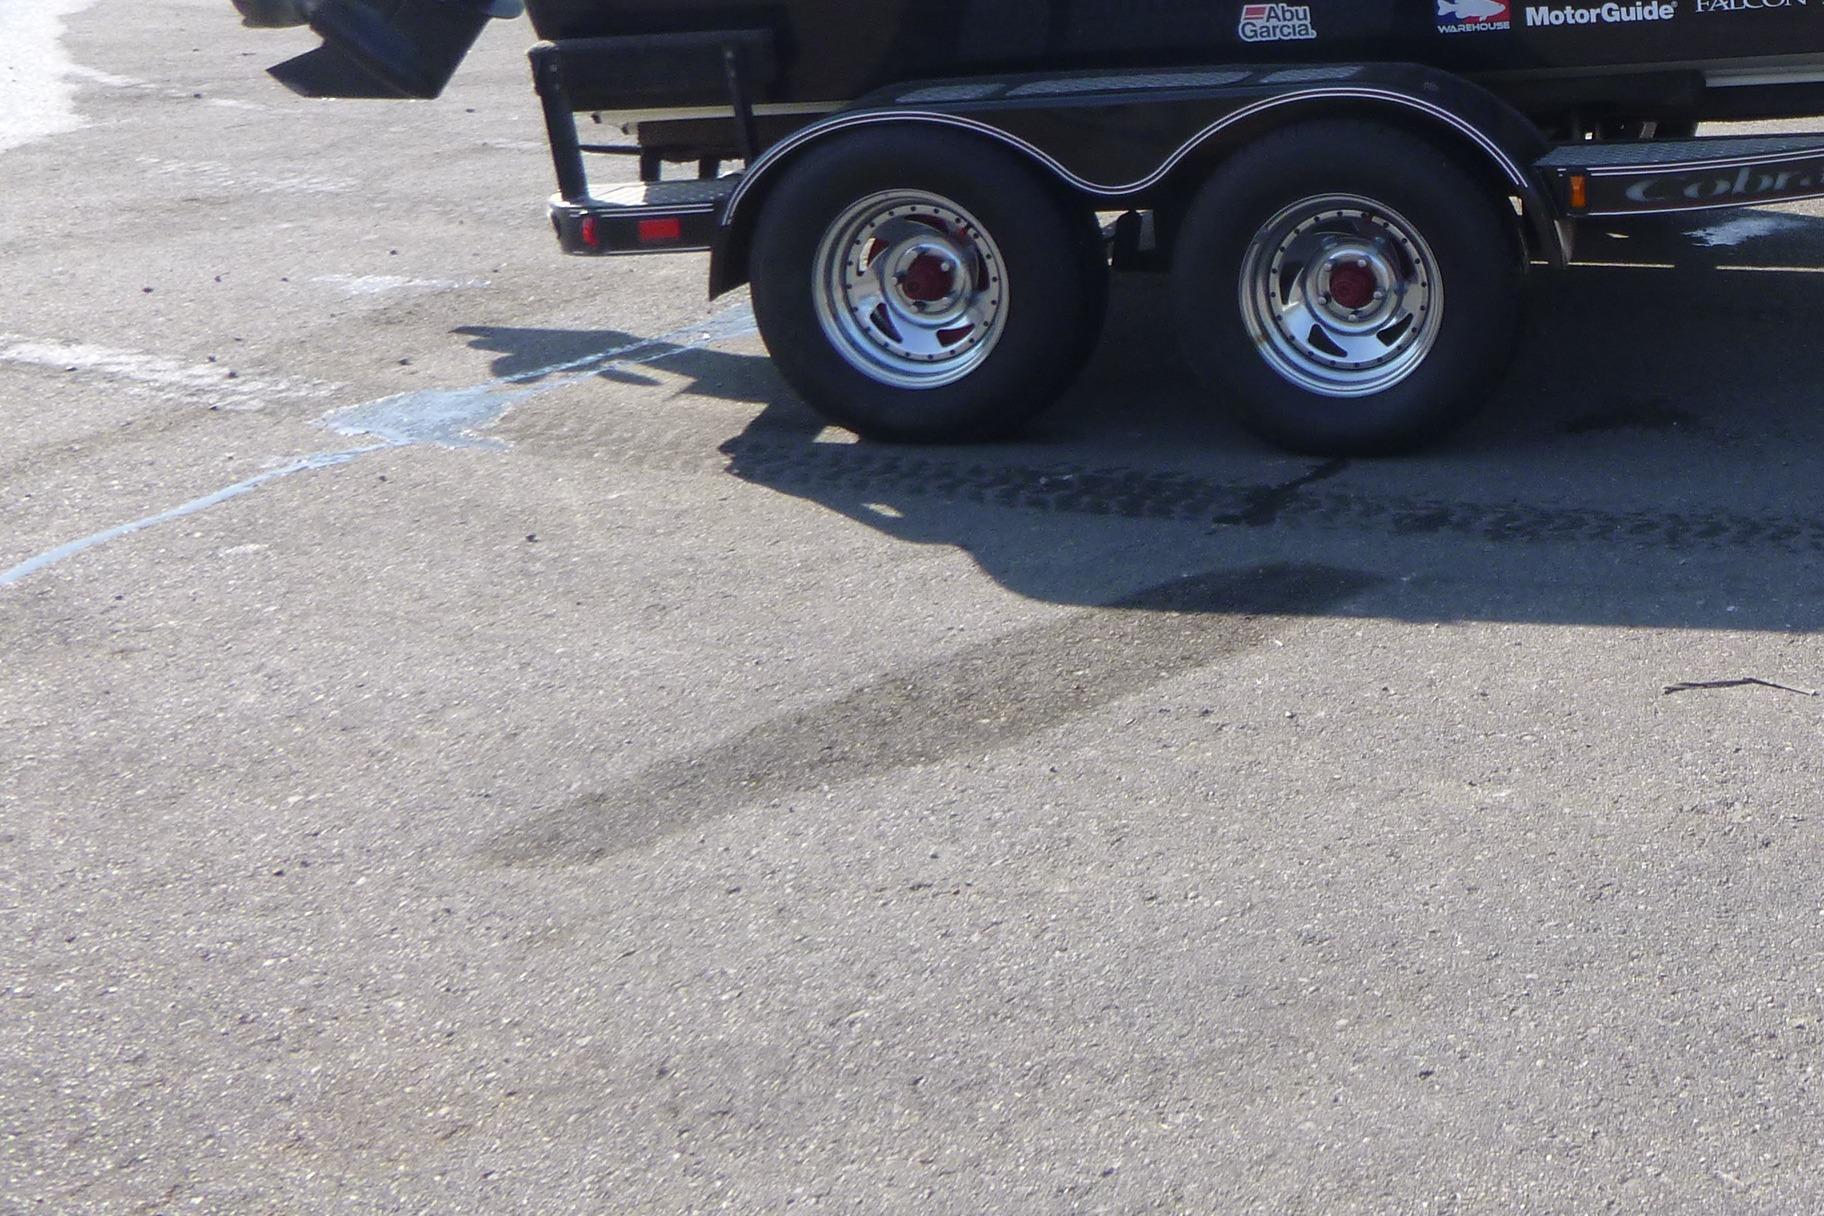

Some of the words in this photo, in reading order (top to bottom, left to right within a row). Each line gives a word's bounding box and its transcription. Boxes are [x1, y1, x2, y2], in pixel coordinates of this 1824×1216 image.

[1266, 4, 1309, 23] Abu
[1525, 0, 1676, 27] MotorGuide
[1437, 21, 1511, 33] WAREHOUSE
